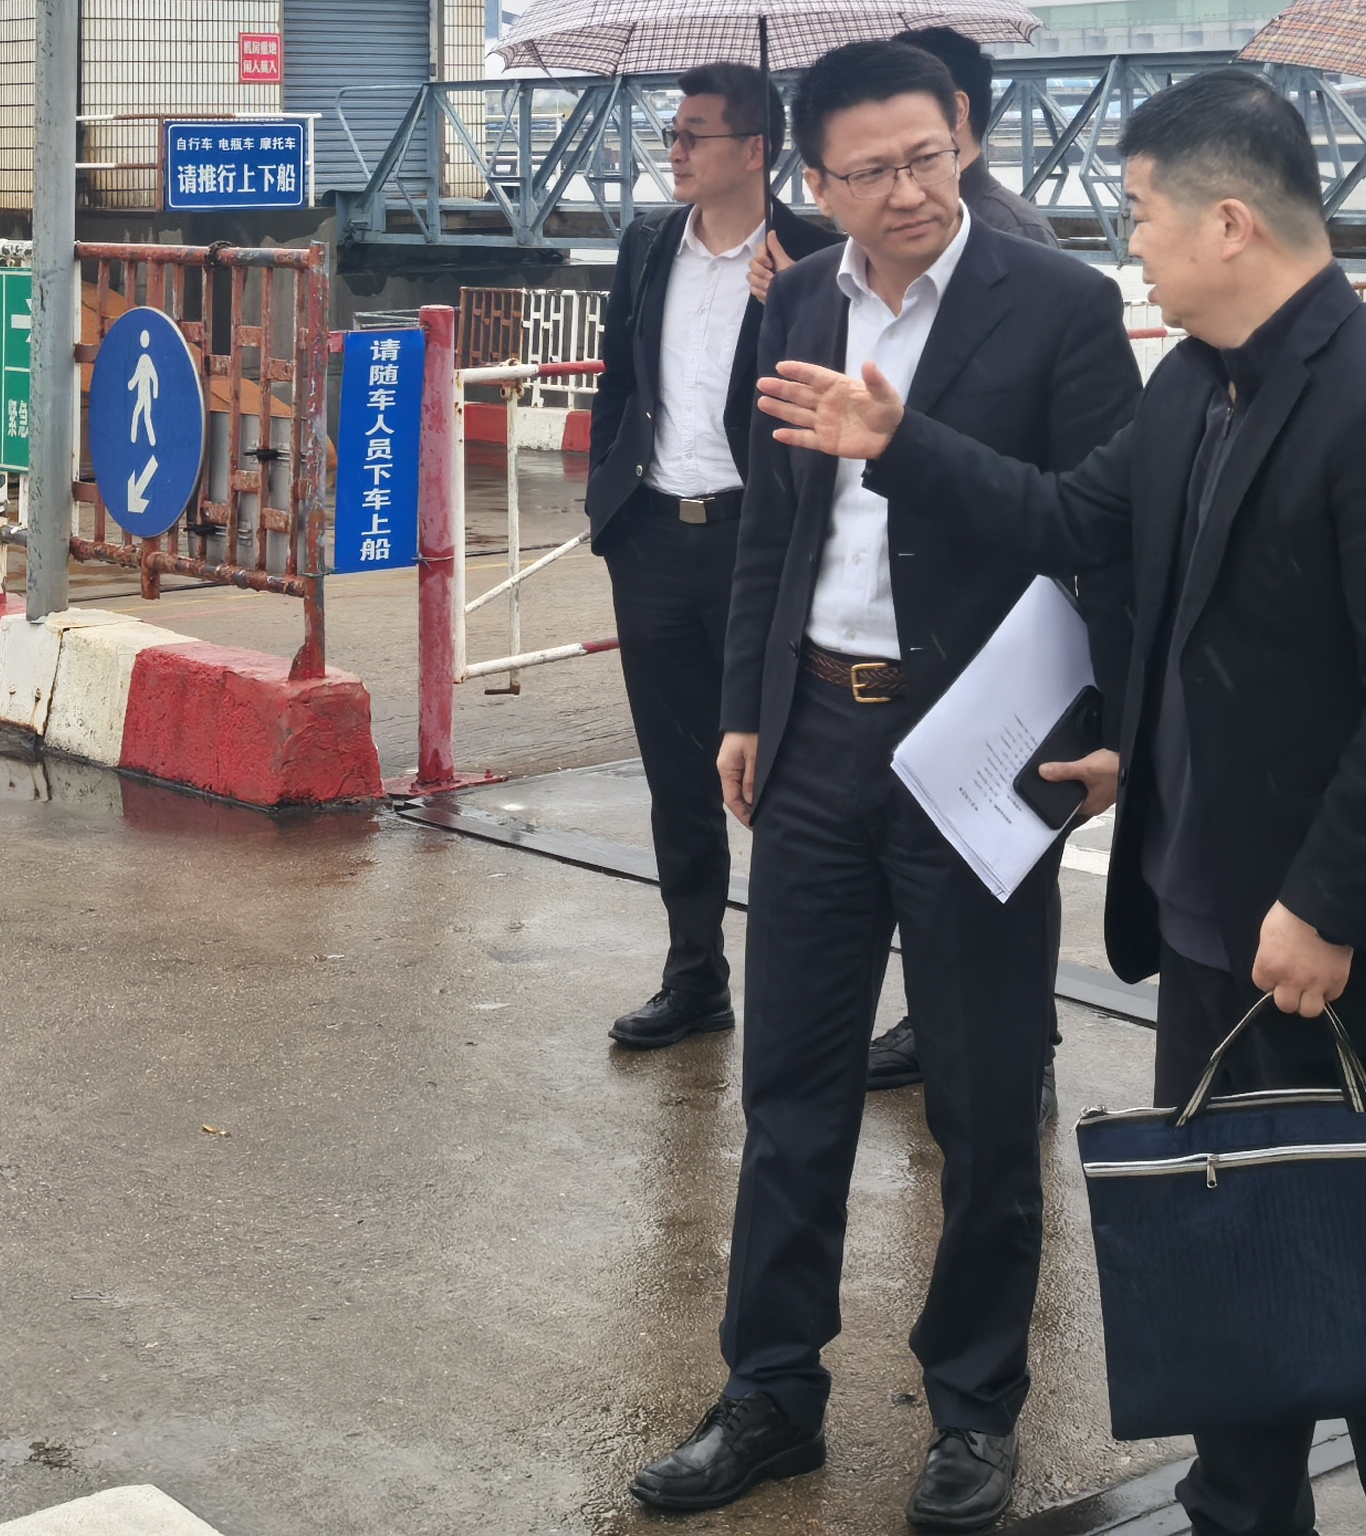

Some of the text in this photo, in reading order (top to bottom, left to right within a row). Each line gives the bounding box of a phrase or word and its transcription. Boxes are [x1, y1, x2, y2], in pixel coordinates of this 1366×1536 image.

[176, 137, 296, 151] 自行车 电瓶车 摩托车
[177, 163, 296, 194] 请推行上下船
[7, 399, 29, 438] 紧急
[359, 338, 401, 561] 请随车人员下车上船
